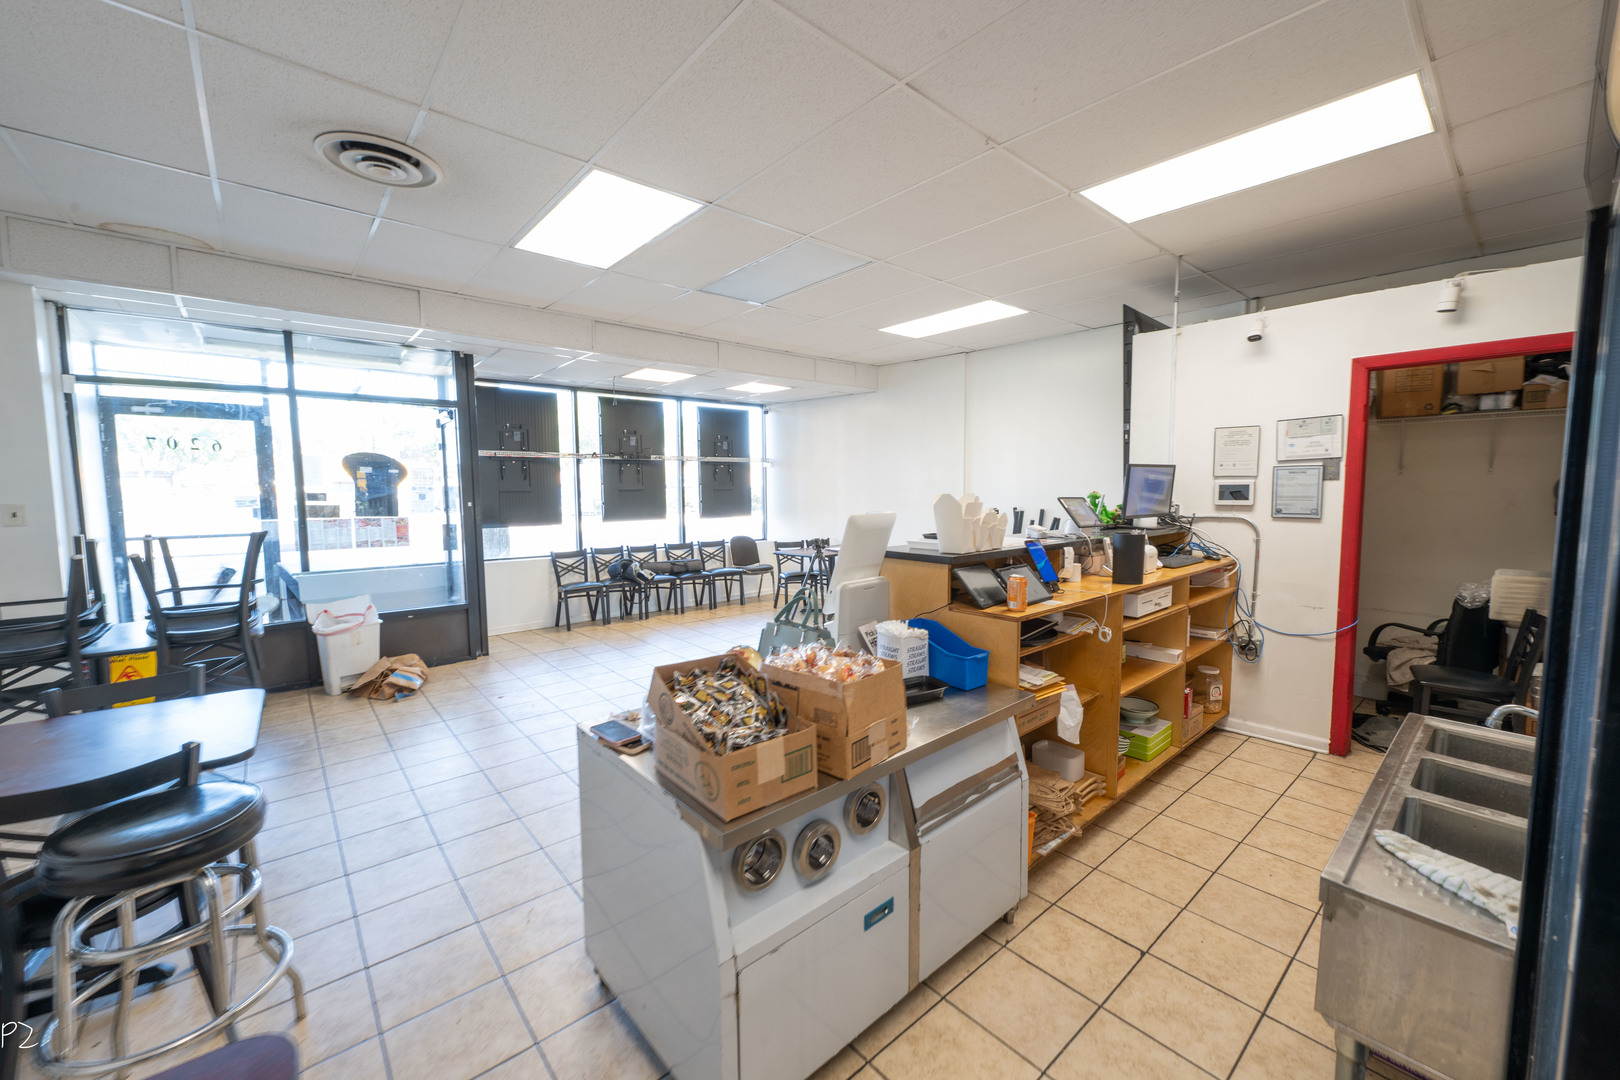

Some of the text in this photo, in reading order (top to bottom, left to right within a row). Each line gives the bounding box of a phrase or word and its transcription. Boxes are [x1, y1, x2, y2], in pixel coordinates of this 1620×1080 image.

[907, 644, 927, 653] STRAIGHT
[908, 651, 926, 660] STRAWS
[906, 657, 927, 667] STRAIGHT
[907, 665, 926, 674] STRAWS
